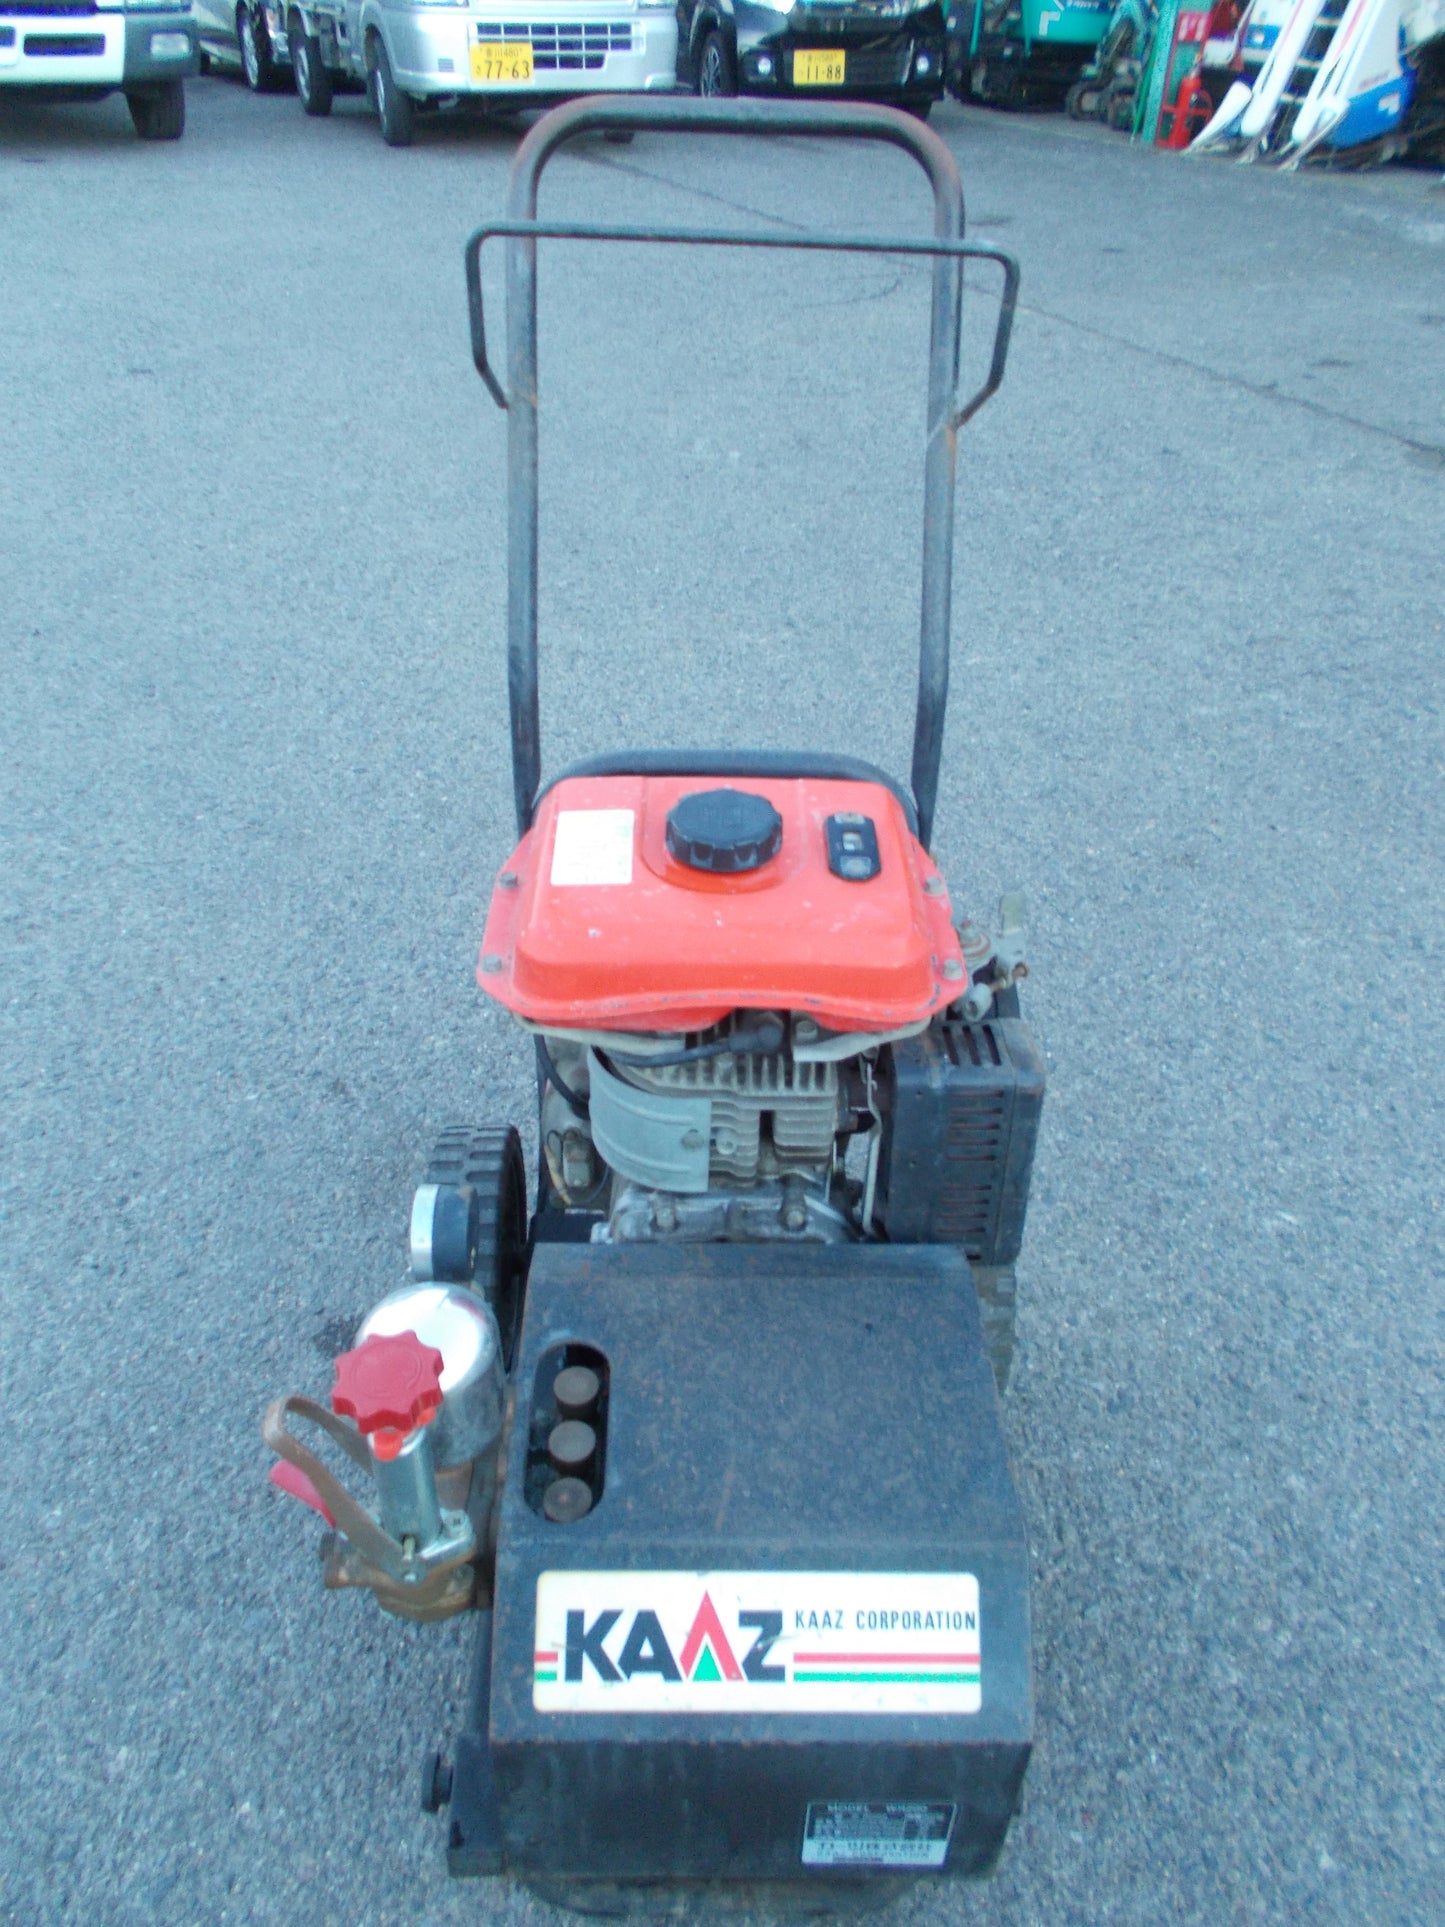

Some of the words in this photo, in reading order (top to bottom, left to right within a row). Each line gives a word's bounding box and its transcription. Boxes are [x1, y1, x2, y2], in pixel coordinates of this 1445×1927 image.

[564, 1589, 787, 1683] KAAZ
[795, 1609, 844, 1630] KAAZ
[856, 1610, 977, 1631] CORPORATION
